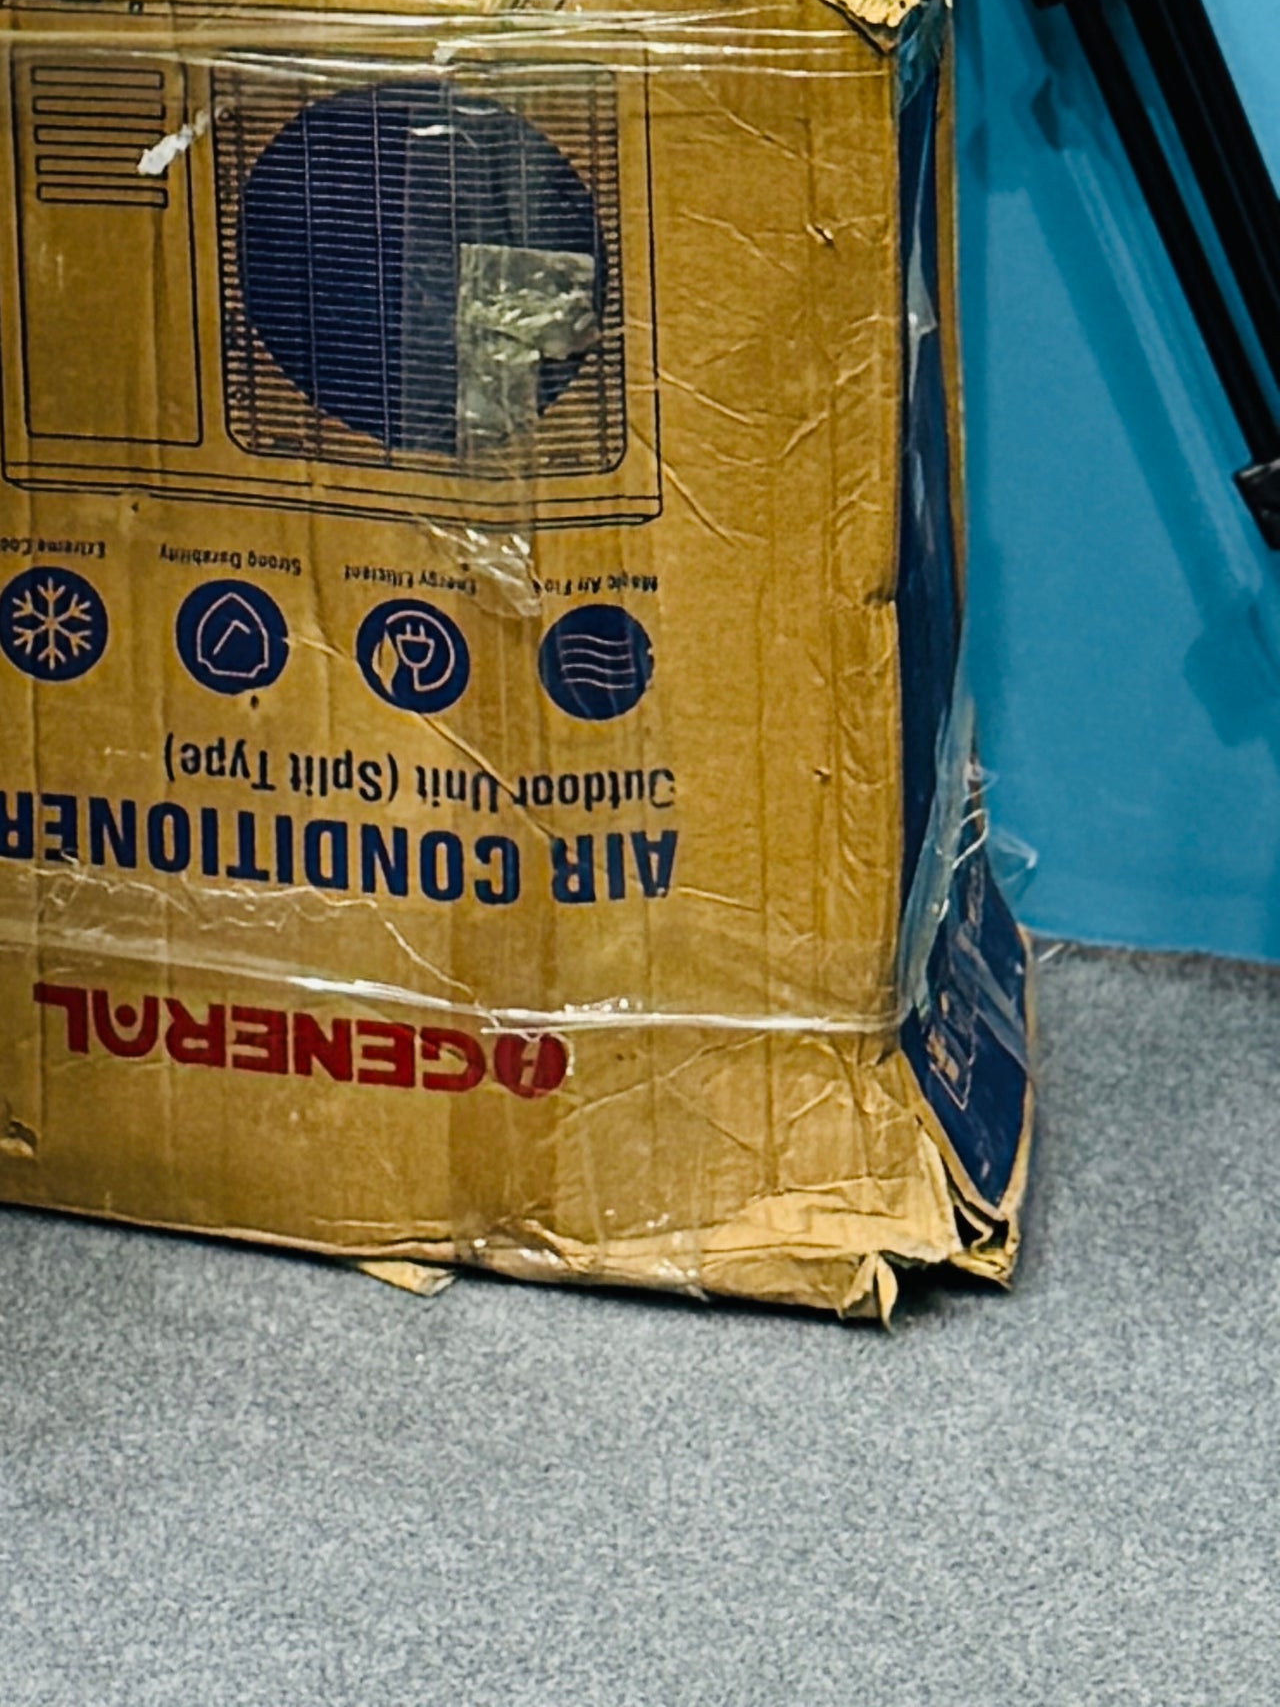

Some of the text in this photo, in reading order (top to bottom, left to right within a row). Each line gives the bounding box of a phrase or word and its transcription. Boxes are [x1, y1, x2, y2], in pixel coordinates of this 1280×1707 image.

[36, 537, 106, 559] Extreme
[157, 542, 301, 576] Strong Durability
[160, 730, 675, 814] Outdoor Unit (Split Type)
[548, 828, 678, 905] AIR
[31, 980, 486, 1093] GENERAL
